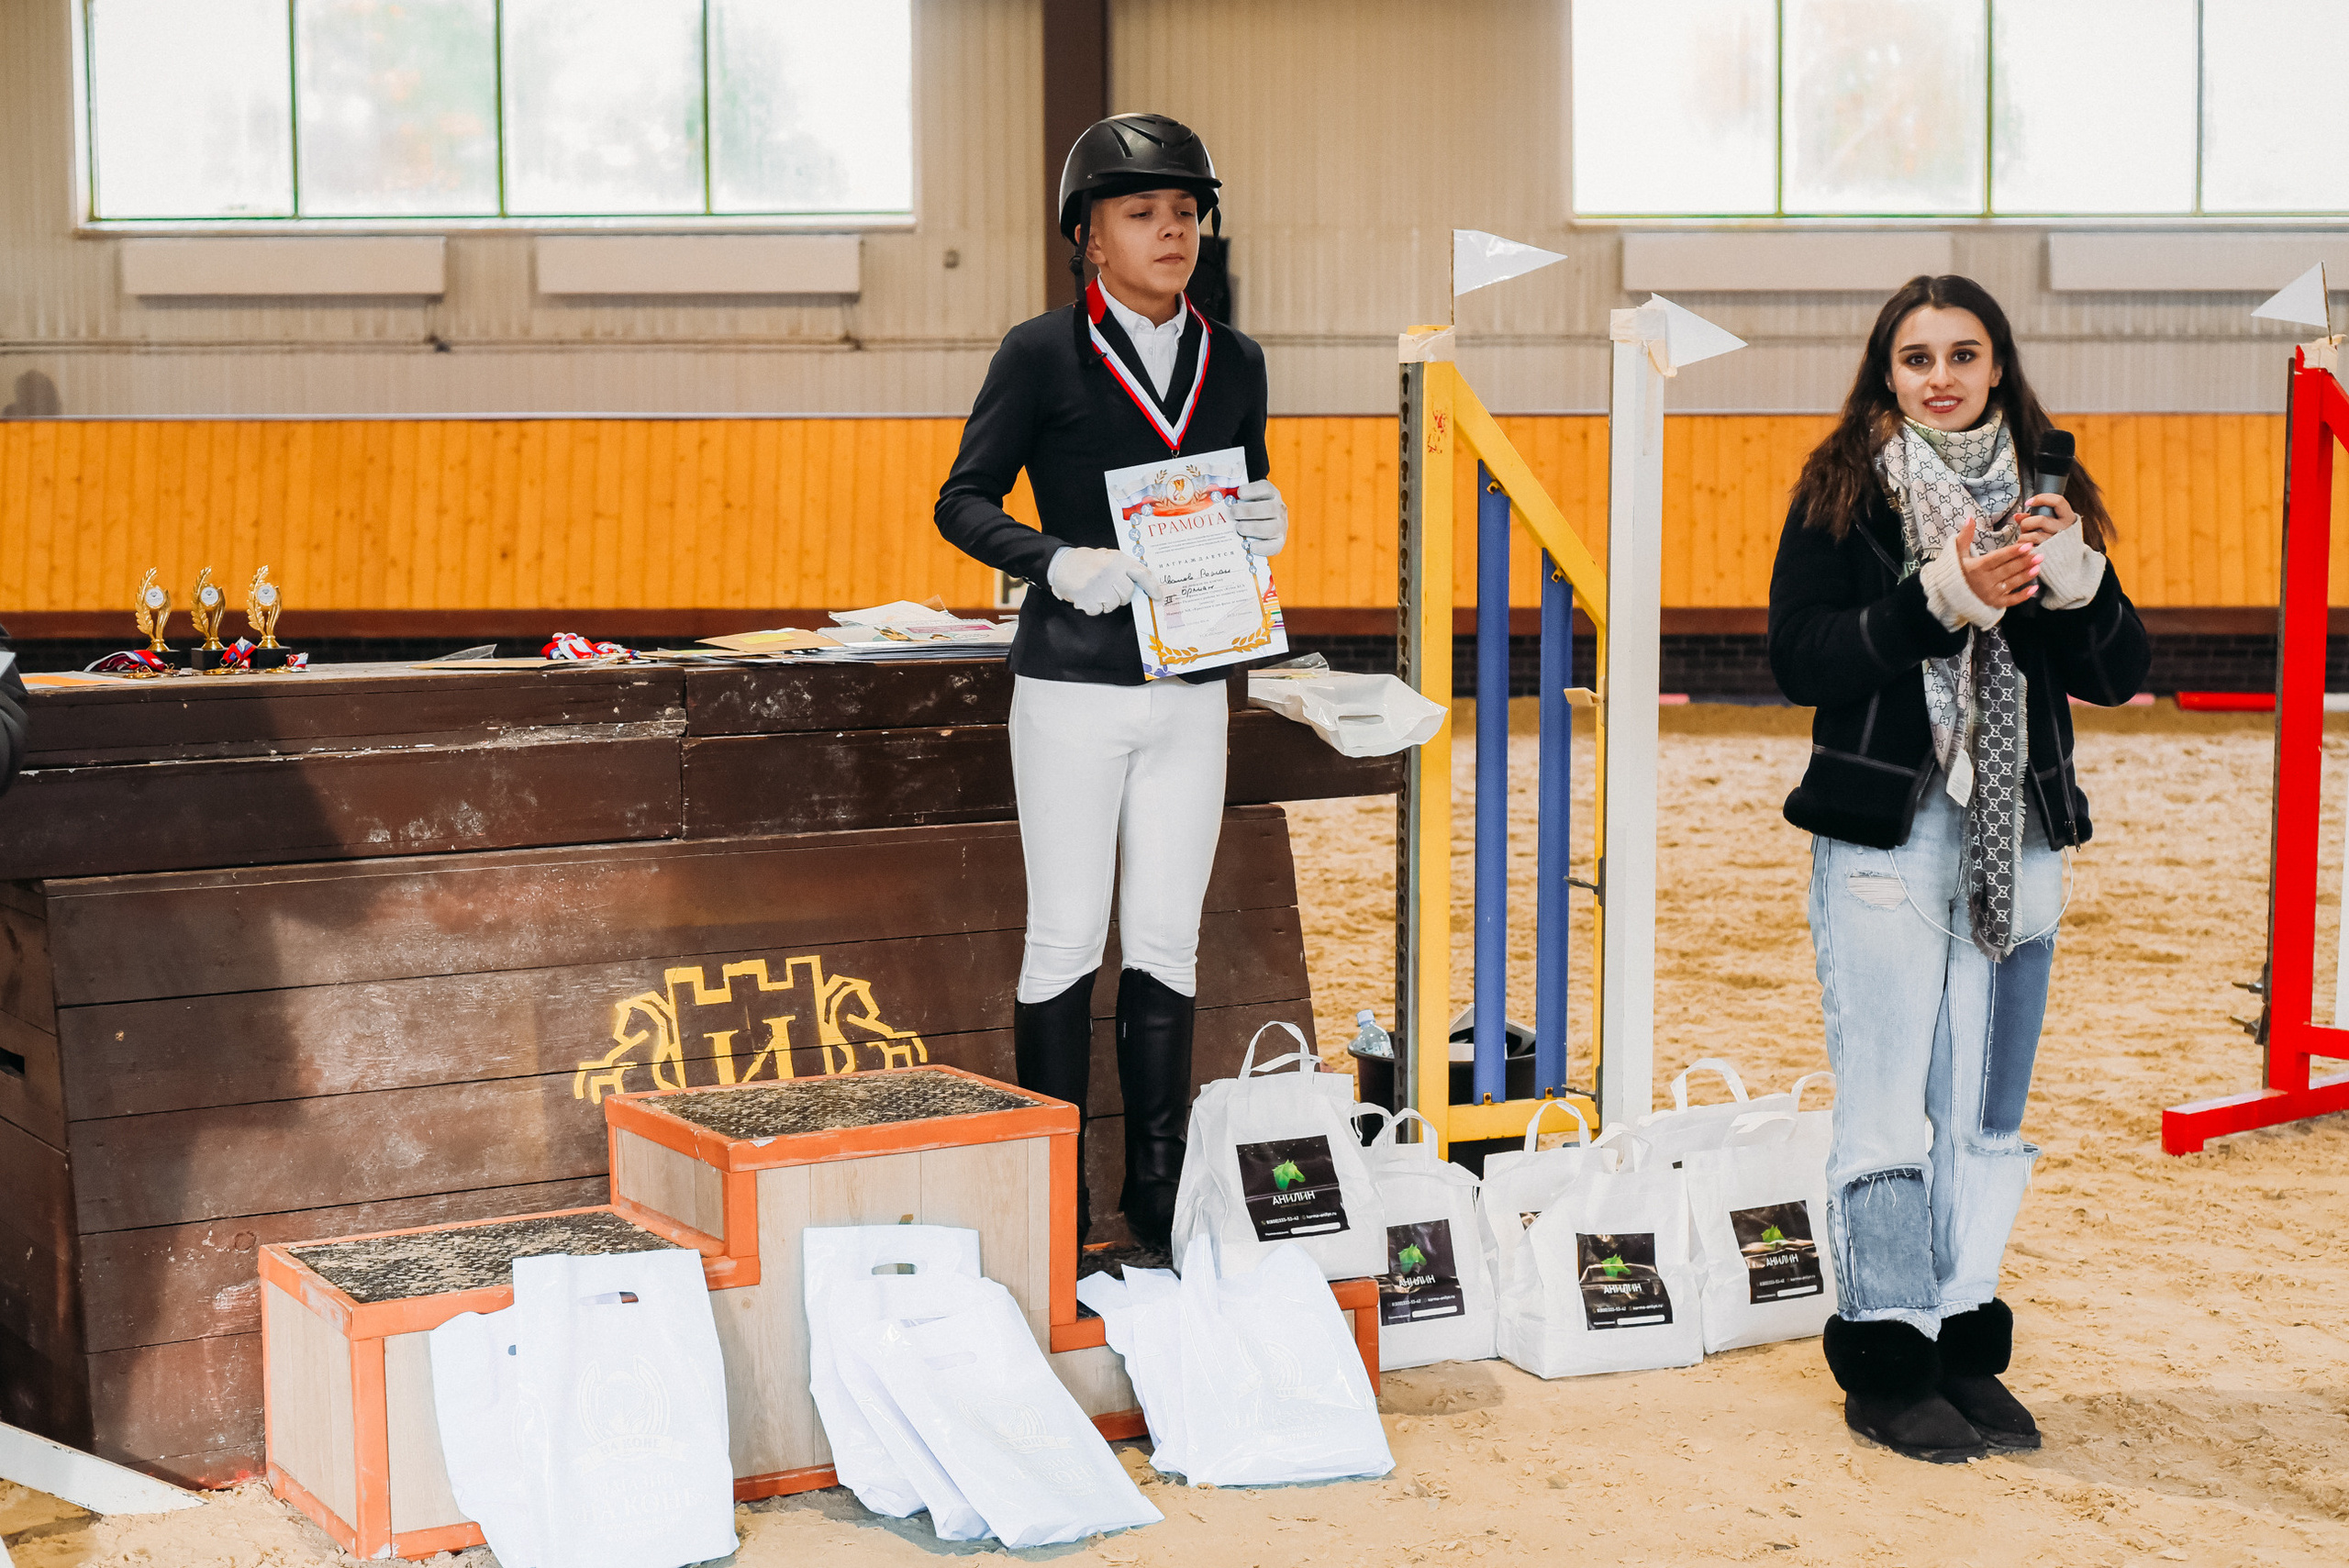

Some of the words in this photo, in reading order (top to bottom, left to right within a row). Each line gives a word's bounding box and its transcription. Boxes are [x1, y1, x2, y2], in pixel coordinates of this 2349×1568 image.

[1148, 512, 1227, 537] ГРАМОТА
[1158, 550, 1234, 569] НАГРАЖДАЕТСЯ
[1272, 1190, 1316, 1206] АНИЛИН
[1765, 1253, 1799, 1267] АНИЛИН
[1398, 1274, 1436, 1287] АНИЛИН
[1603, 1283, 1642, 1295] АНИЛИН
